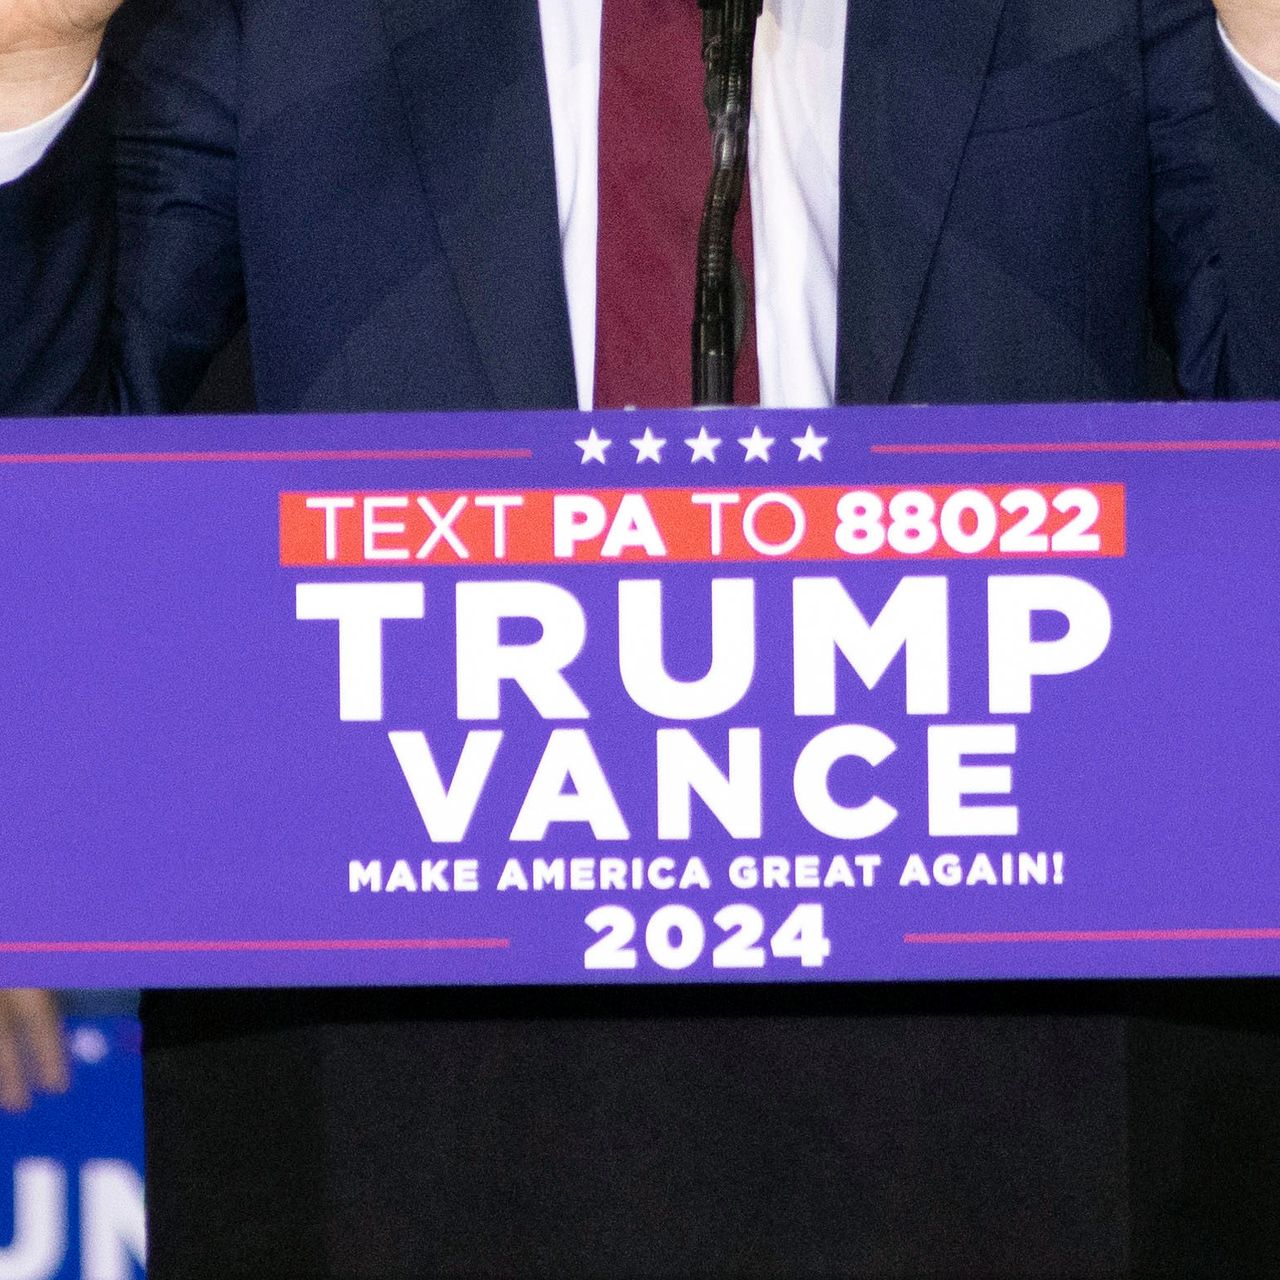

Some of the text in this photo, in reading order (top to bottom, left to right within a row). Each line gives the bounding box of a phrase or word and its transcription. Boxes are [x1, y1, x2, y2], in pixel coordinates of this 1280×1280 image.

[305, 488, 1101, 560] TEXT PA TO 88022
[295, 574, 1112, 721] TRUMP
[387, 723, 1019, 843] VANCE
[348, 851, 1064, 893] MAKE AMERICA GREAT AGAIN!
[584, 902, 831, 970] 2024
